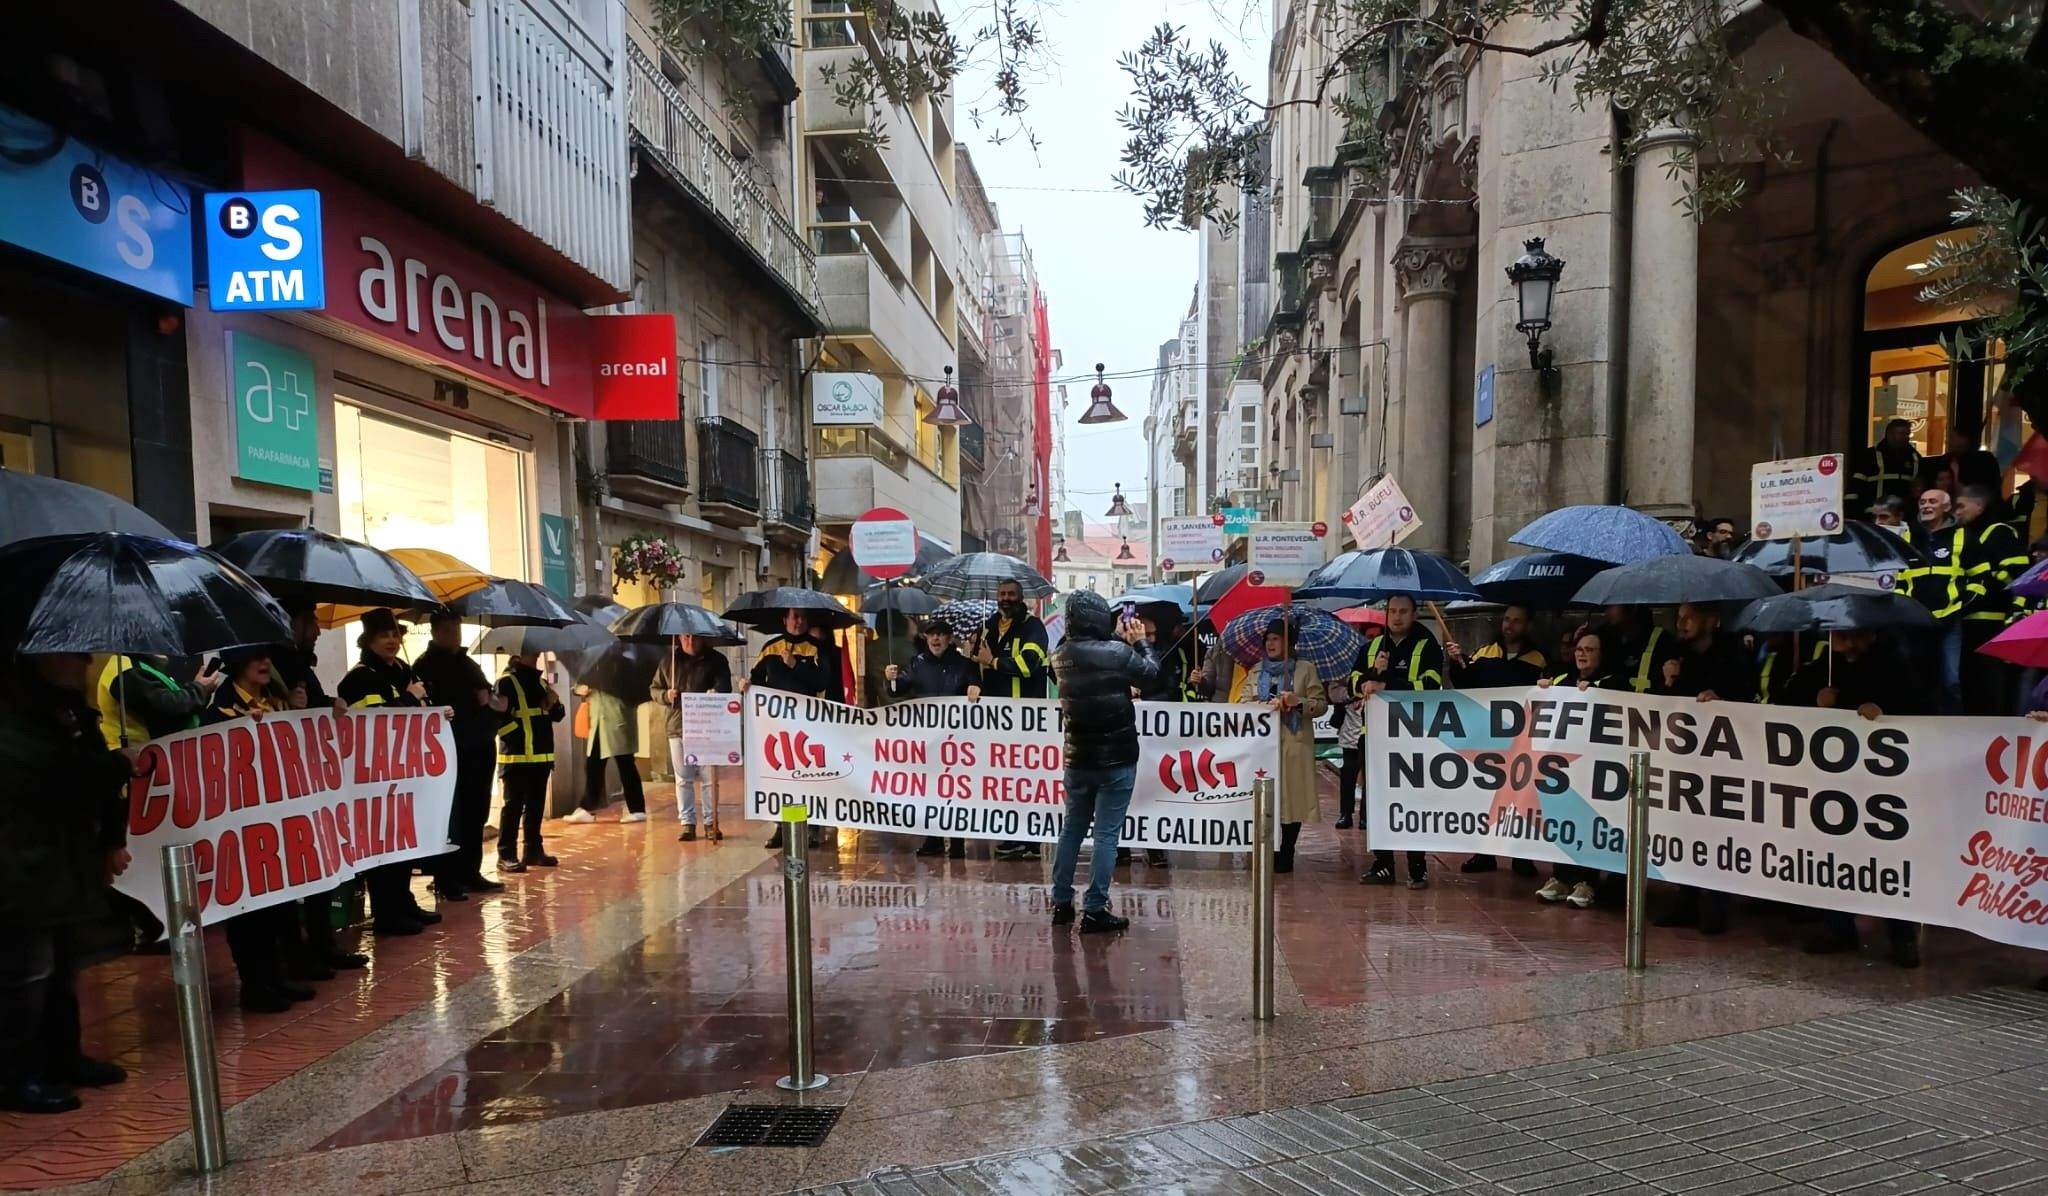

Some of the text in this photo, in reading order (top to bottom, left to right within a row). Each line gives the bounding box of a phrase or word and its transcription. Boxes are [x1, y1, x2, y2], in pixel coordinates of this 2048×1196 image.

[81, 176, 154, 270] B S
[230, 204, 303, 261] B S
[226, 269, 305, 303] ATM
[359, 236, 550, 386] arenal
[600, 357, 667, 376] arenal
[248, 445, 311, 470] PARAFARMACIA
[1780, 474, 1814, 487] MOAÑA
[1528, 564, 1565, 577] LANZAL
[755, 693, 796, 720] POR
[805, 698, 878, 726] UNHAS
[885, 697, 1013, 731] CONDICIÓNS
[1022, 706, 1048, 732] DE
[1180, 711, 1271, 738] DIGNAS
[764, 730, 826, 771] CIG
[874, 734, 1060, 771] NON ÓS RECO
[1388, 700, 1910, 777] NA DEFENSA DOS
[791, 769, 841, 780] Correos
[871, 767, 1068, 805] NON ÓS RECAR
[1159, 748, 1237, 795] CIG
[1388, 752, 1910, 841] NOSOS DEREITOS
[1985, 790, 2048, 822] CORRE
[835, 798, 916, 829] CORREO
[925, 799, 1019, 835] PÚBLICO
[1121, 816, 1151, 843] DE
[1158, 817, 1253, 846] CALIDAD
[1389, 802, 1911, 898] Correos Público, Gago e de Calidade!
